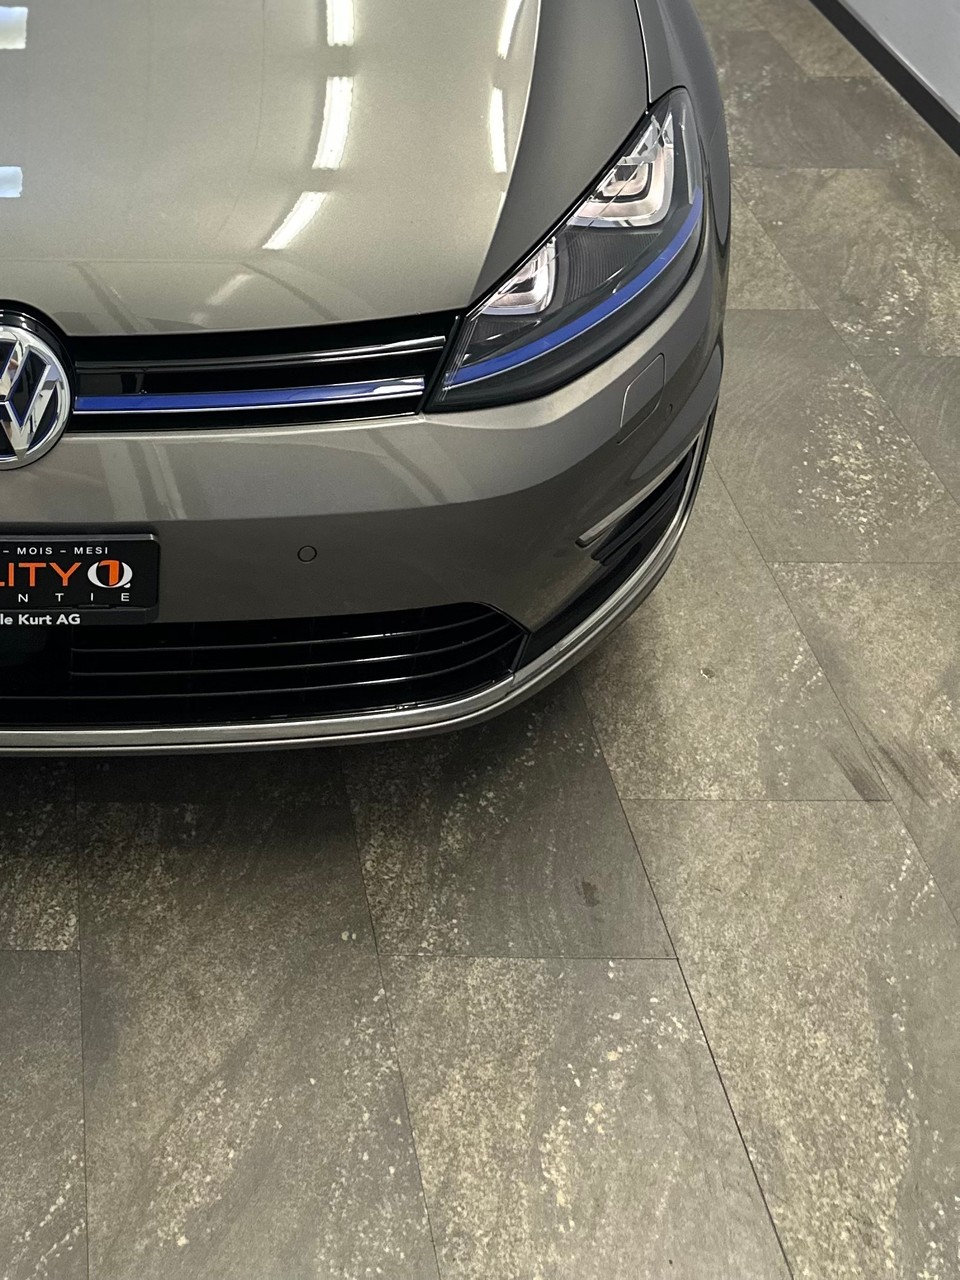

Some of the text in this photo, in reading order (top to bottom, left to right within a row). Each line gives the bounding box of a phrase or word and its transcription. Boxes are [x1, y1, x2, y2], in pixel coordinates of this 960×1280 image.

[16, 546, 53, 555] MOIS
[74, 546, 108, 555] MESI
[18, 613, 53, 625] Kurt
[56, 614, 81, 625] AG
